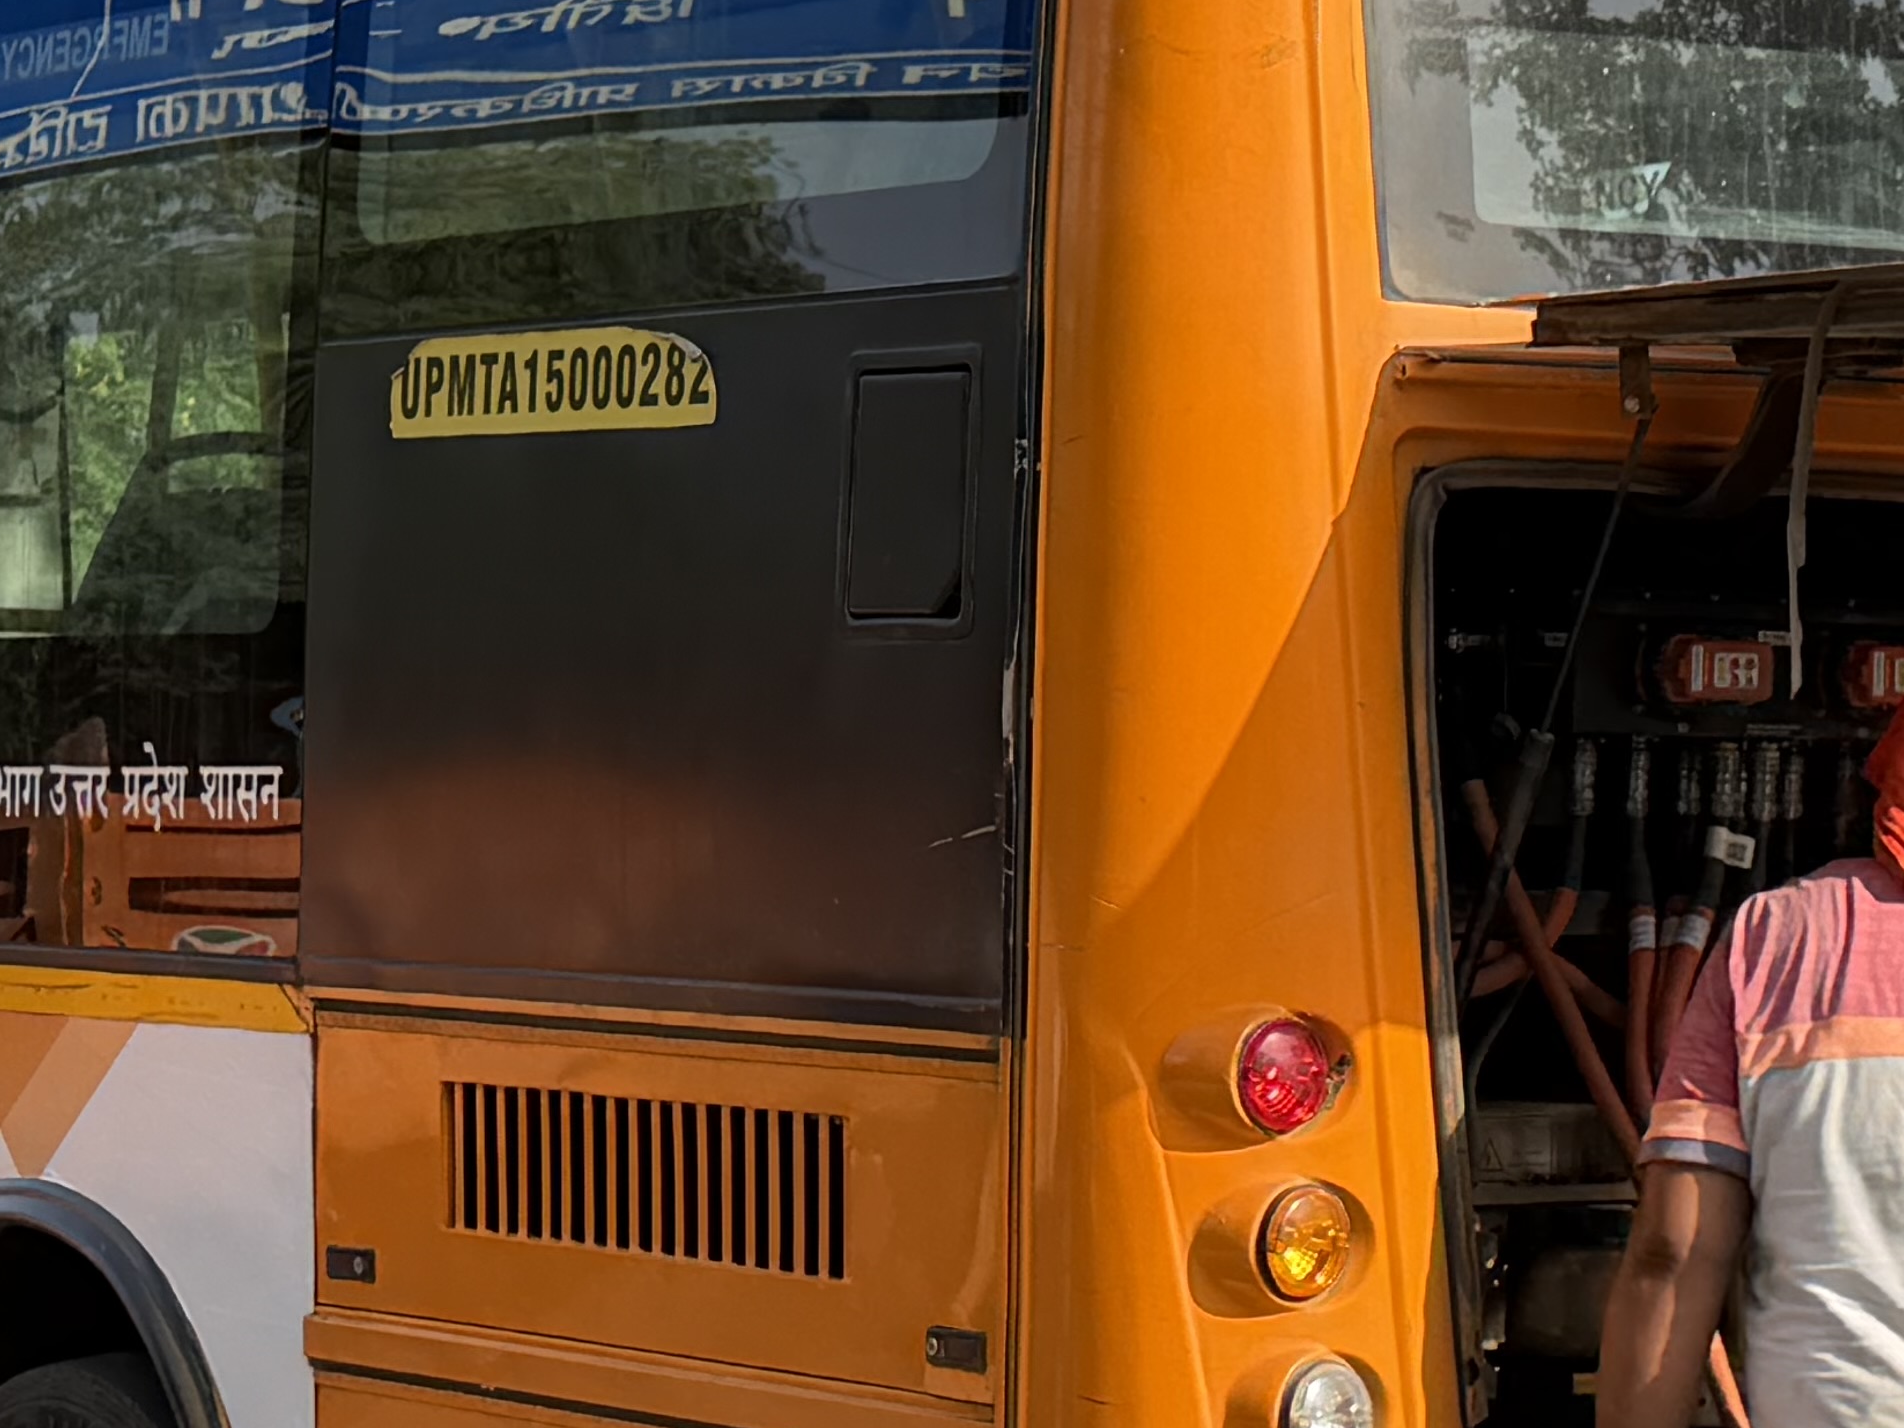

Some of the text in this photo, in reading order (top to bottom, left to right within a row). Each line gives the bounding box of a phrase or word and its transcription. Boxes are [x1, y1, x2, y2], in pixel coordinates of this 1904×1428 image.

[400, 342, 711, 420] UPMTA15000282
[48, 763, 111, 818] उत्तर
[120, 741, 189, 832] प्रदेश
[199, 763, 284, 821] शासन
